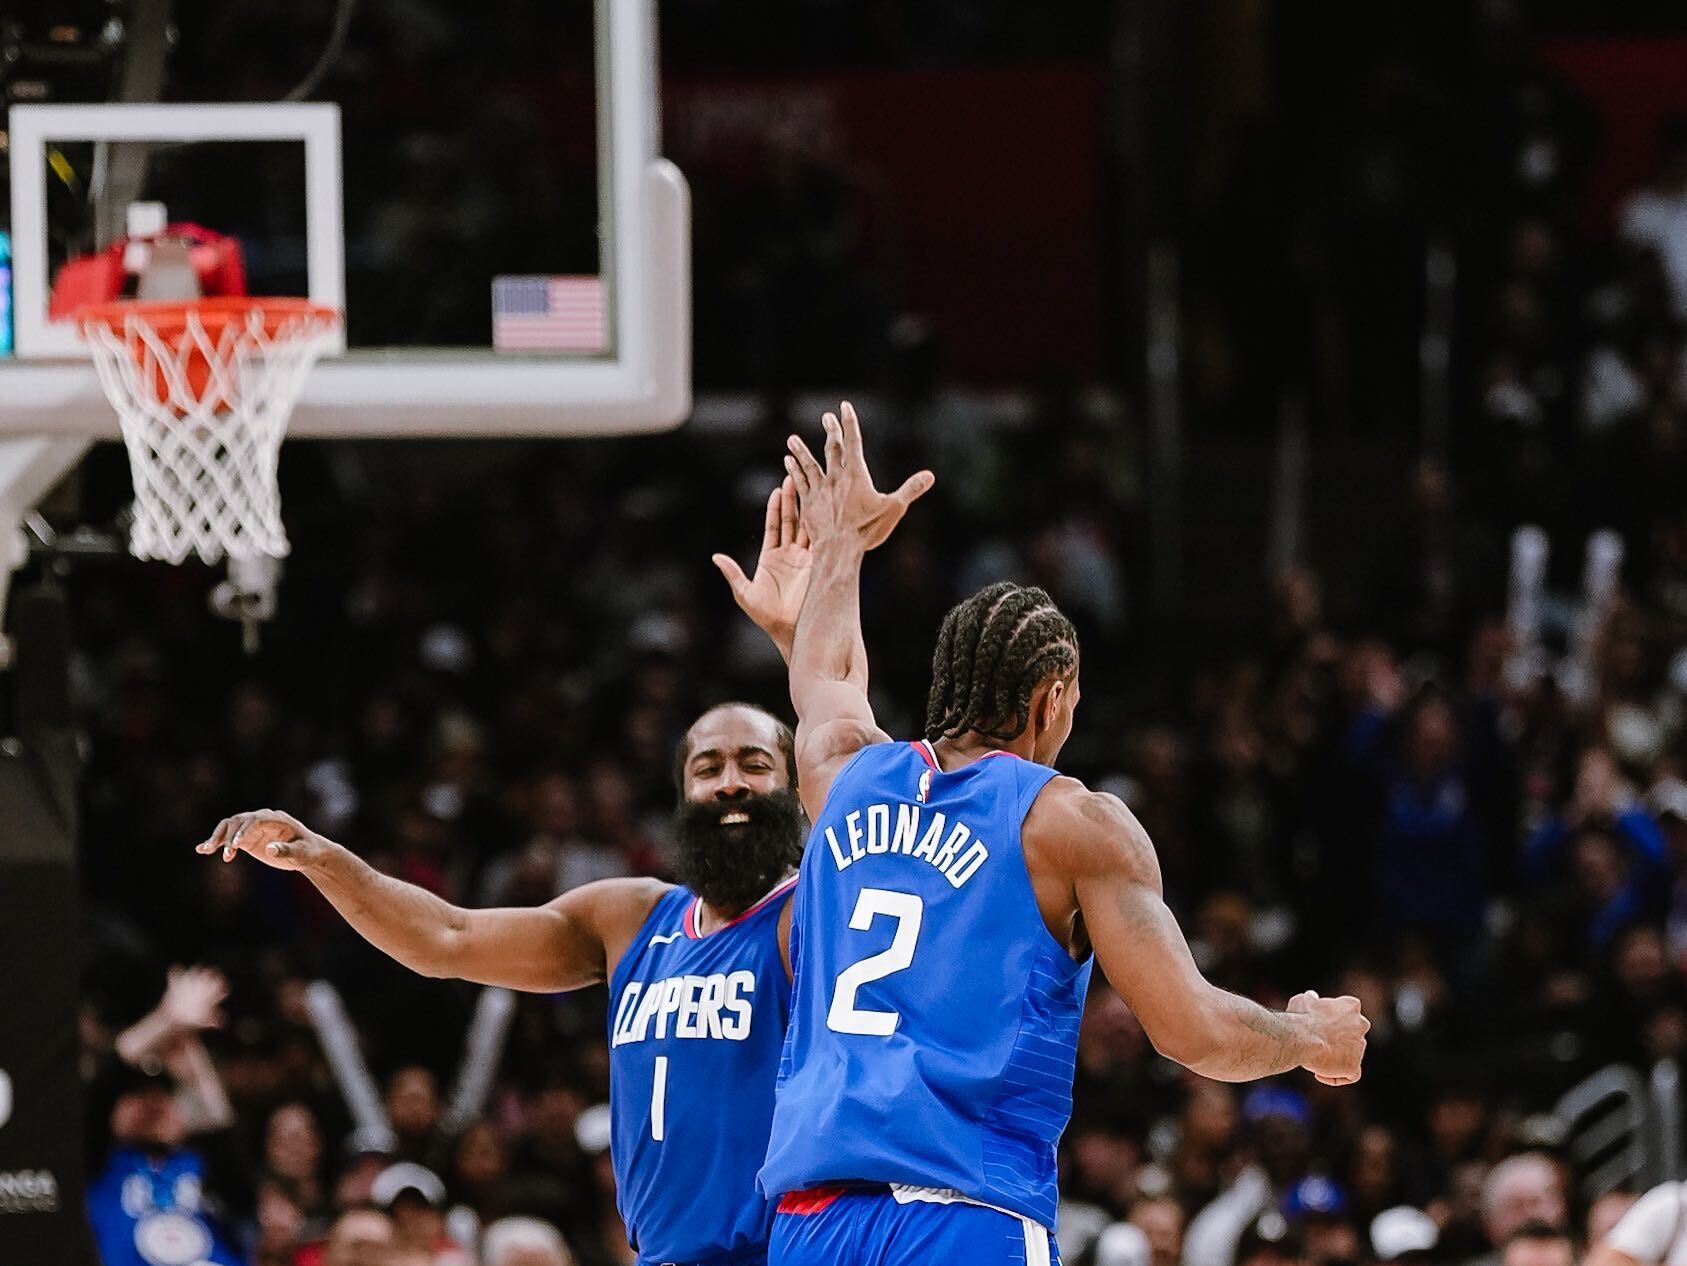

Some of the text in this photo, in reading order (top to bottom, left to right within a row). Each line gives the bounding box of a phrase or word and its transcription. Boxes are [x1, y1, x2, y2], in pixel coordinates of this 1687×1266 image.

[825, 803, 989, 889] LEONARD
[826, 887, 924, 1036] 2
[612, 970, 756, 1049] CLIPPERS
[652, 1056, 668, 1141] 1
